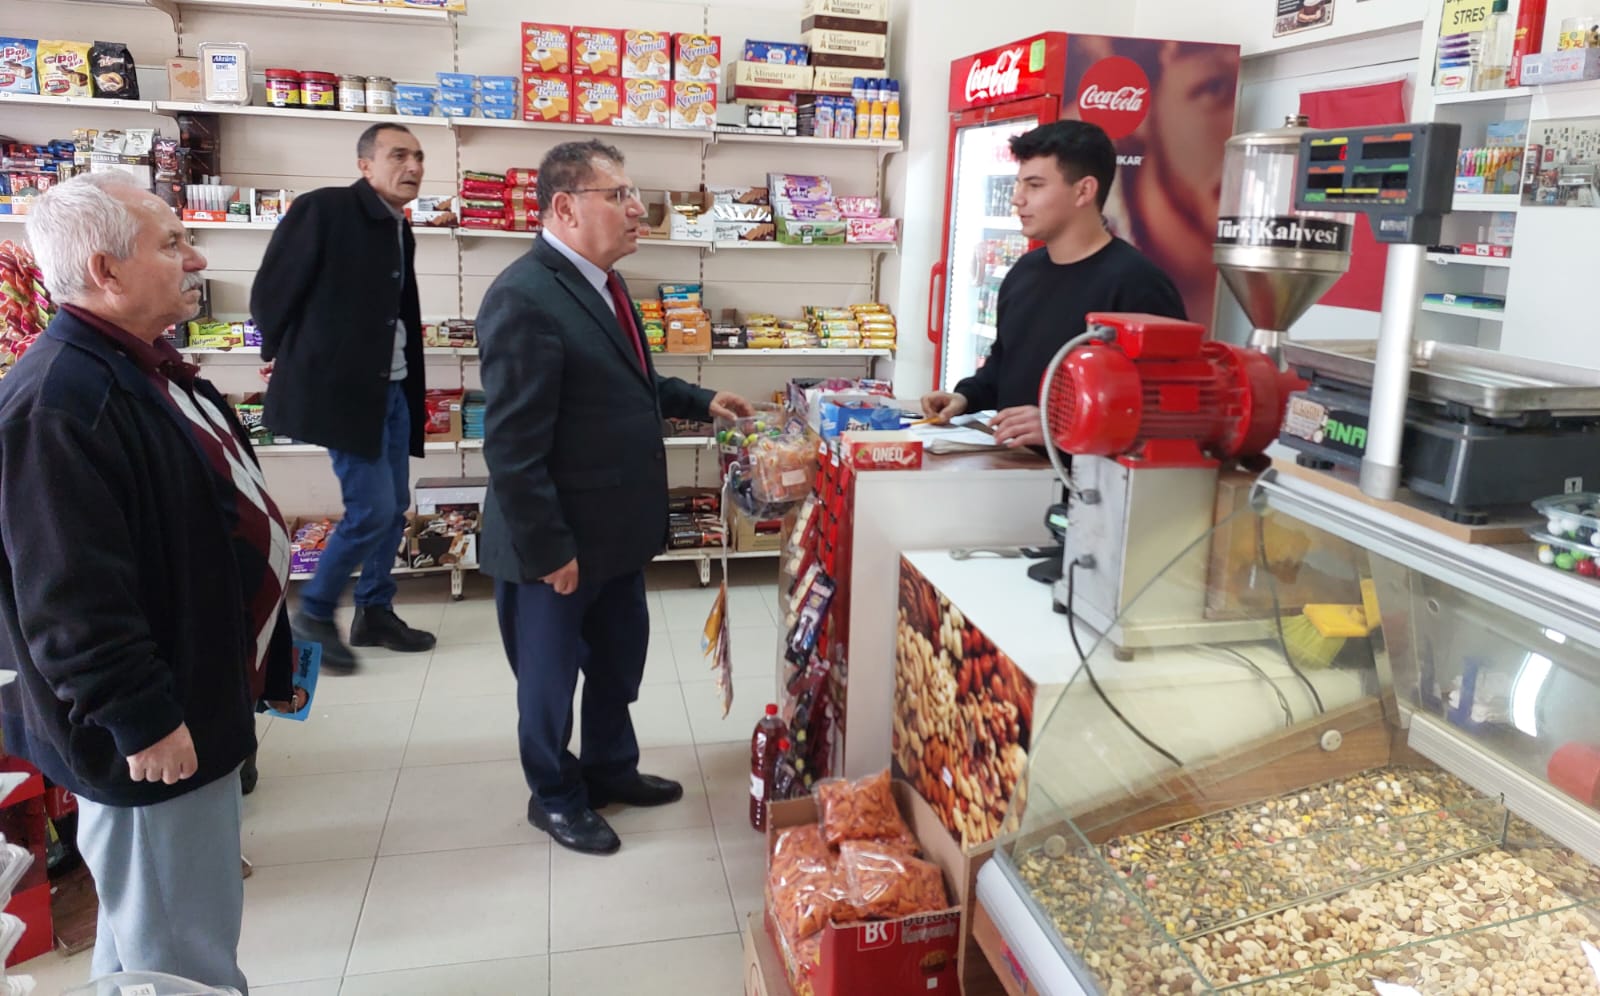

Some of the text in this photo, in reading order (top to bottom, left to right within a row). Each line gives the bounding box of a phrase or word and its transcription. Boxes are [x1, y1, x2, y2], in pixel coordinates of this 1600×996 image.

[1452, 7, 1486, 26] STRES
[829, 33, 871, 47] Minnettar
[1217, 220, 1339, 244] Türk Kahvesi
